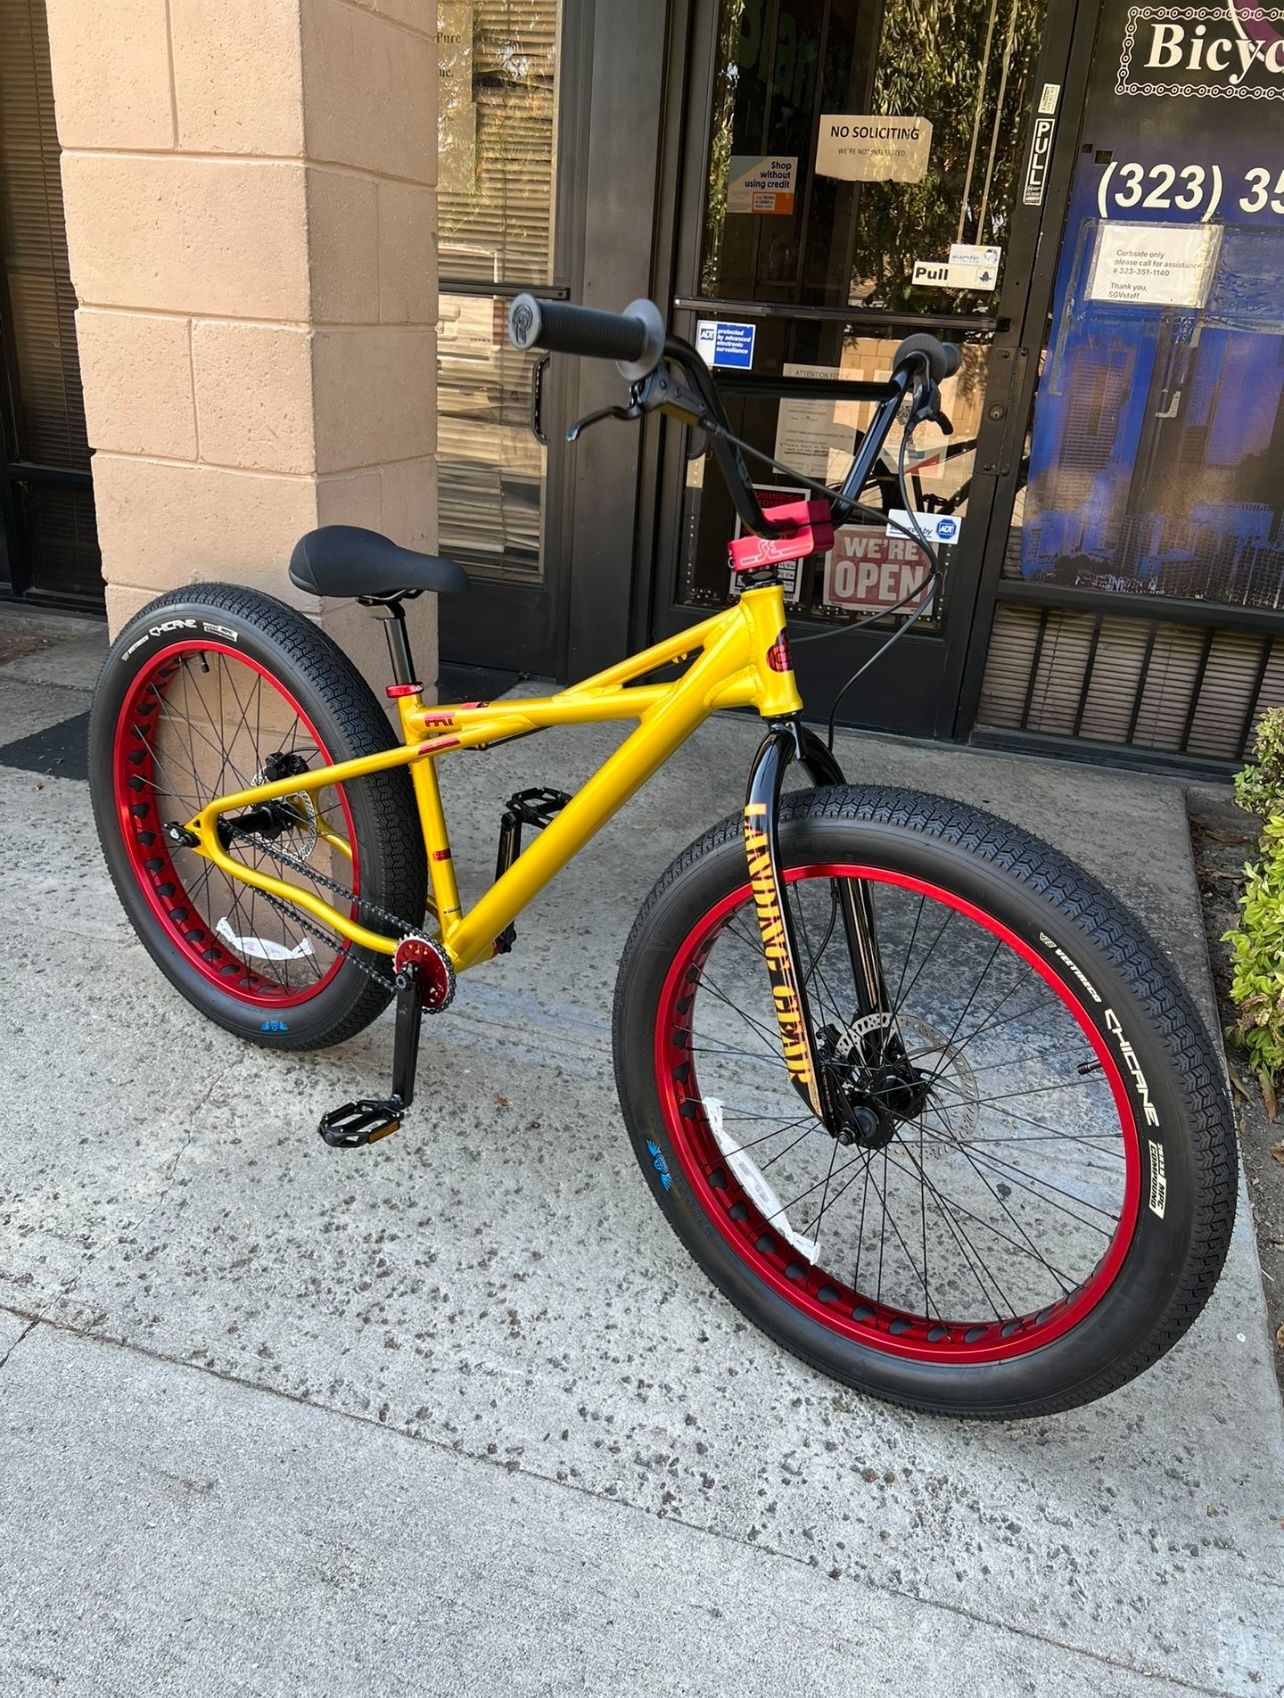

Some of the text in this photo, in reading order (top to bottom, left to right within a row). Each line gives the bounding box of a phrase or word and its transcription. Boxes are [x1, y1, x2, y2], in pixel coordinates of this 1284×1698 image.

[830, 125, 920, 140] NO SOLICITING
[1029, 121, 1050, 185] PULL
[771, 161, 792, 171] Shop
[760, 170, 791, 179] without
[745, 180, 790, 189] using credit
[1097, 161, 1223, 223] (323)
[1116, 249, 1165, 259] Curbside only
[1114, 259, 1138, 267] please
[1139, 259, 1151, 267] call
[915, 267, 949, 281] Pull
[1119, 268, 1170, 277] 323-351-1140
[1111, 282, 1148, 292] Thank you,
[701, 329, 714, 340] ADT
[795, 370, 829, 379] ATTENTION
[843, 536, 920, 562] WE'RE
[834, 560, 924, 602] OPEN
[744, 803, 812, 1084] LANDING GEAR
[1104, 1008, 1160, 1127] CHICANE
